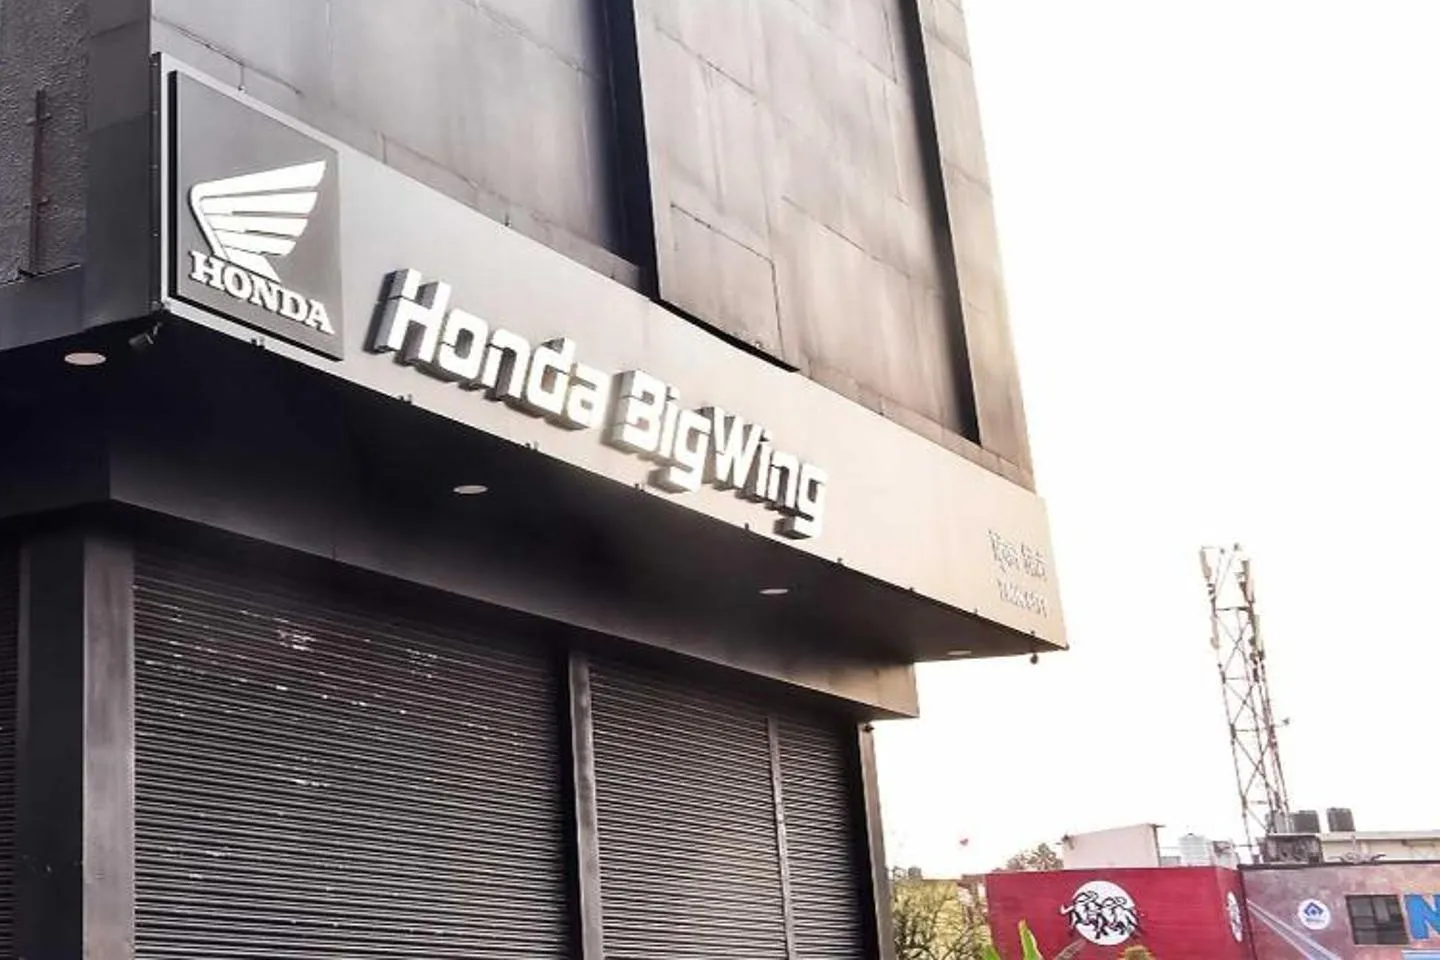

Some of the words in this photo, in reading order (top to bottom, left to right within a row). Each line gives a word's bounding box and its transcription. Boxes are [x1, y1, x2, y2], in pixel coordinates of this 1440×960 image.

[189, 250, 336, 335] HONDA
[372, 268, 610, 430] Honda
[614, 369, 828, 539] BigWing
